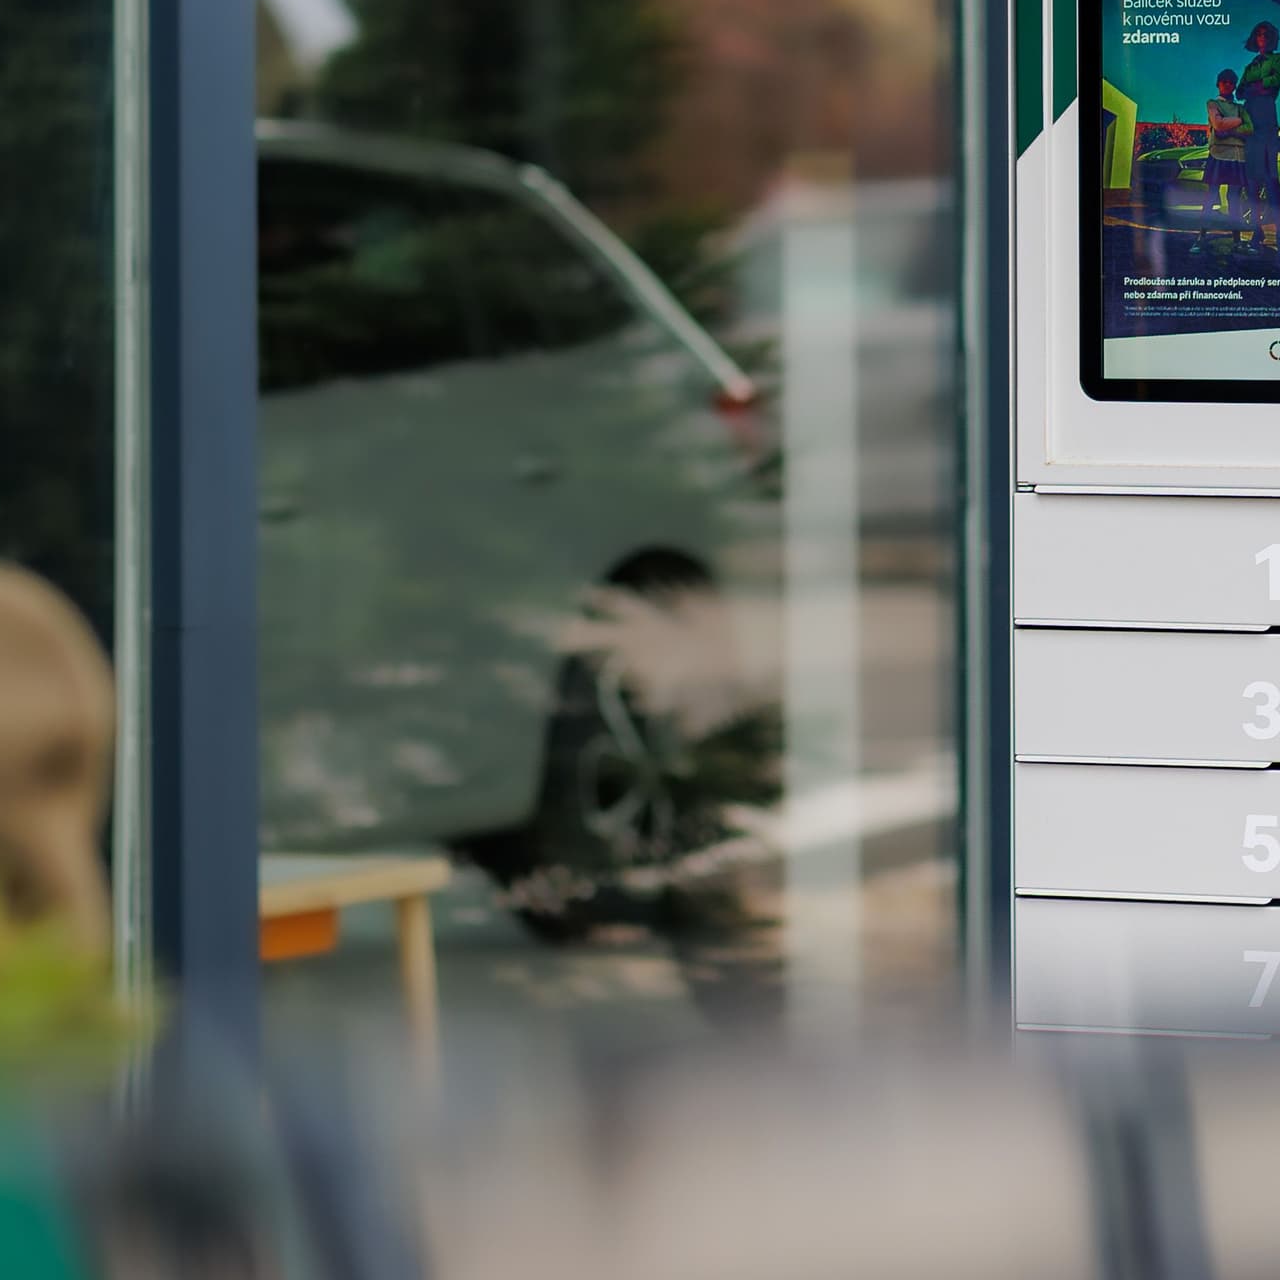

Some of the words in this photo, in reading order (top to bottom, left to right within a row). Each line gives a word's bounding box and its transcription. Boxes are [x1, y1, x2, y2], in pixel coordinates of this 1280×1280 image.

[1122, 11, 1132, 26] k
[1135, 10, 1193, 26] novému
[1196, 14, 1230, 26] vozu
[1122, 29, 1180, 44] zdarma
[1123, 276, 1176, 286] Prodloužená
[1177, 276, 1205, 286] záruka
[1213, 276, 1266, 289] předplacený
[1123, 290, 1146, 300] nebo
[1147, 290, 1178, 300] zdarma
[1179, 290, 1192, 301] při
[1192, 290, 1243, 300] financování.
